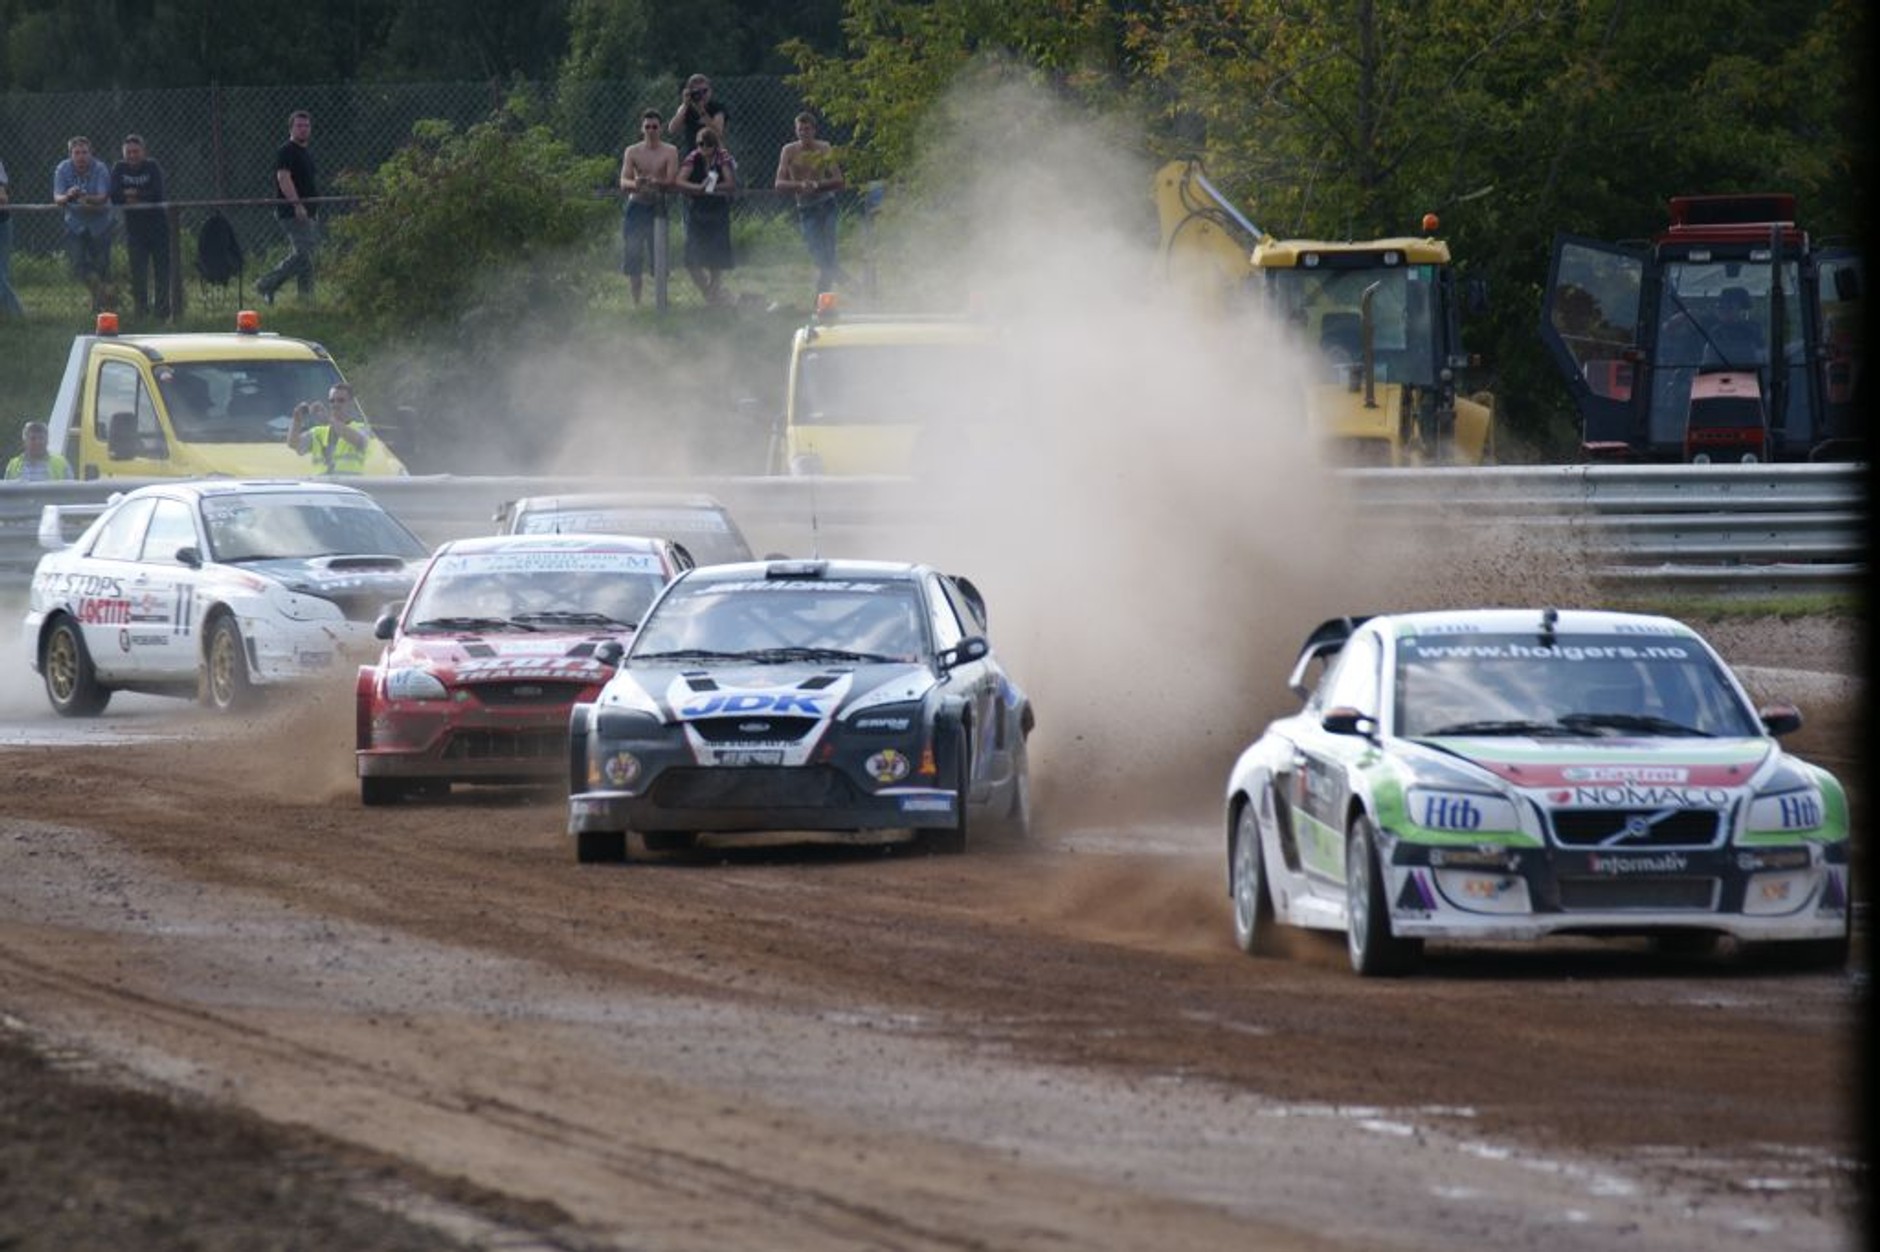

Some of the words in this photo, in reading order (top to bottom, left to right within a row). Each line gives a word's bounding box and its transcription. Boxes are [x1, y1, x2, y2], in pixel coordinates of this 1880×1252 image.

[1417, 643, 1689, 661] www.holgers.no
[681, 695, 822, 716] JDK
[1594, 767, 1680, 781] Castrol
[1575, 787, 1730, 807] NOMACO
[1424, 796, 1482, 829] Htb
[1588, 853, 1689, 874] informativ
